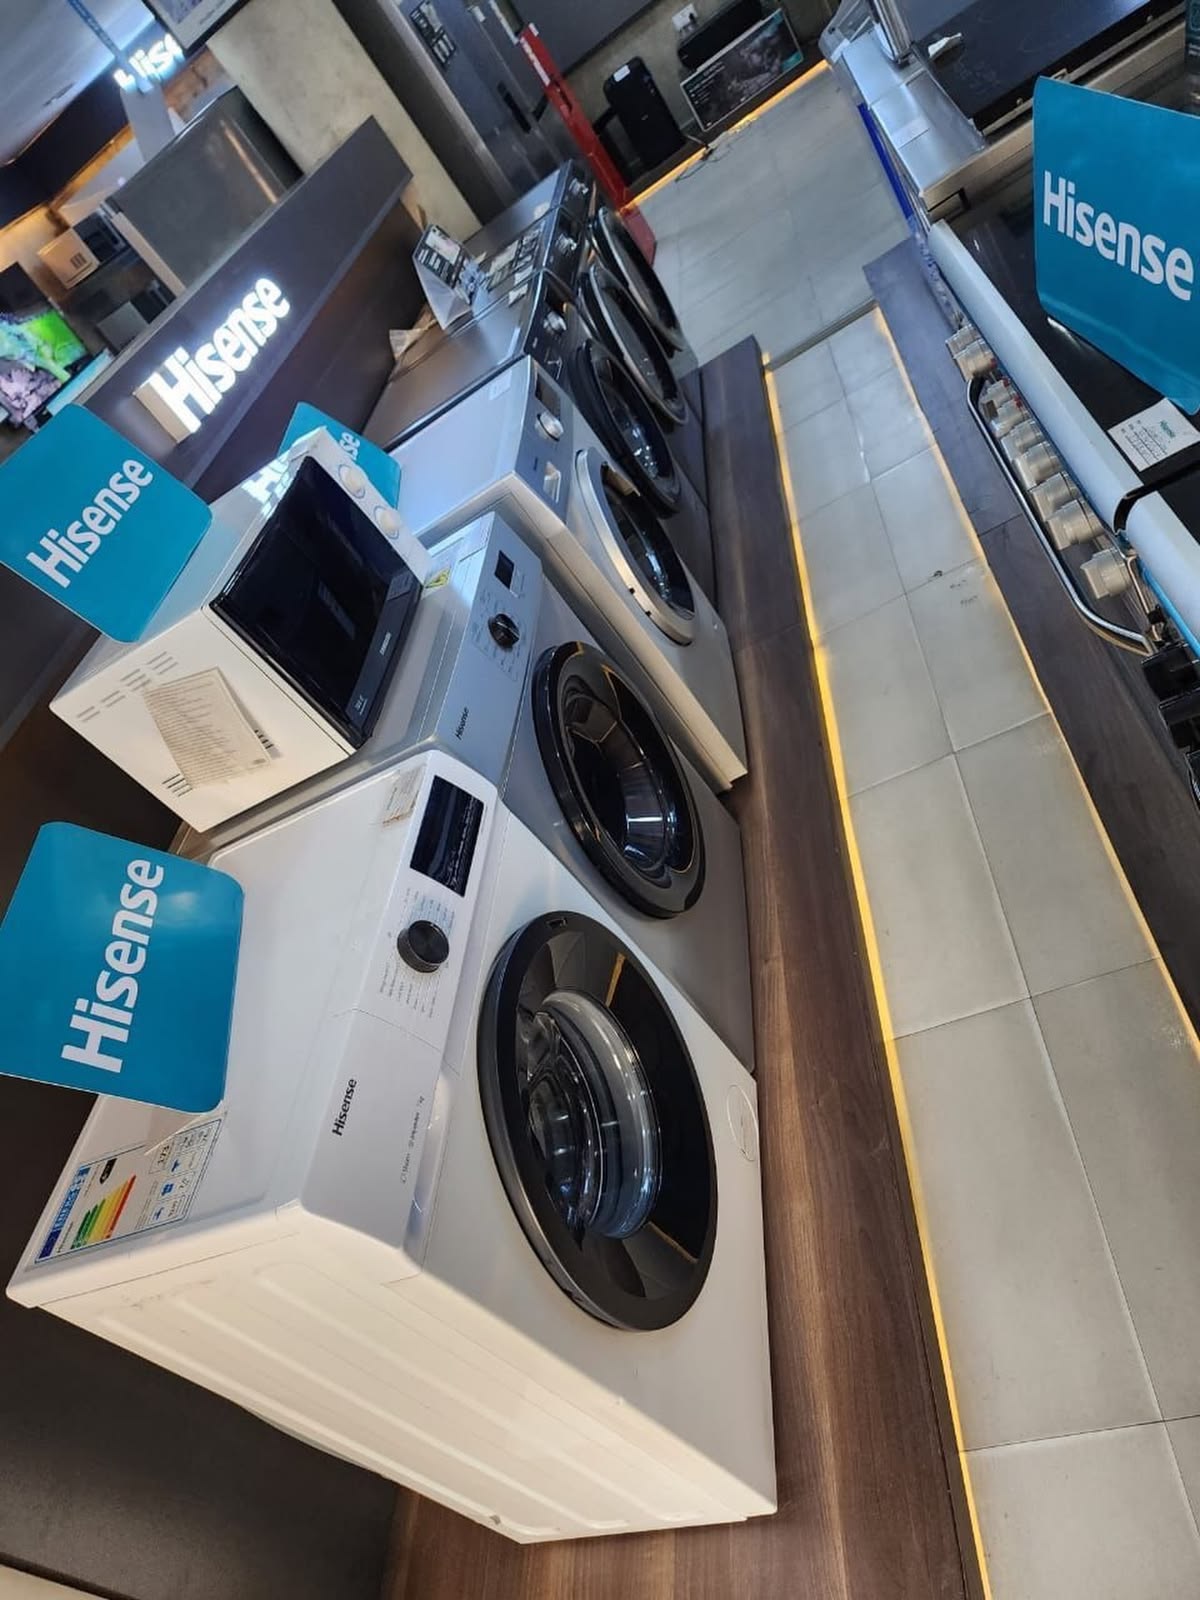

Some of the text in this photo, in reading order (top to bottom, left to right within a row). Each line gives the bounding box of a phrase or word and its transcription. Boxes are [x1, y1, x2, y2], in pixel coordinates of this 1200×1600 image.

[1043, 171, 1193, 301] Hisense
[148, 277, 291, 433] Hisense
[26, 458, 153, 588] Hisense
[61, 859, 164, 1073] Hisense
[332, 1078, 358, 1137] Hisense
